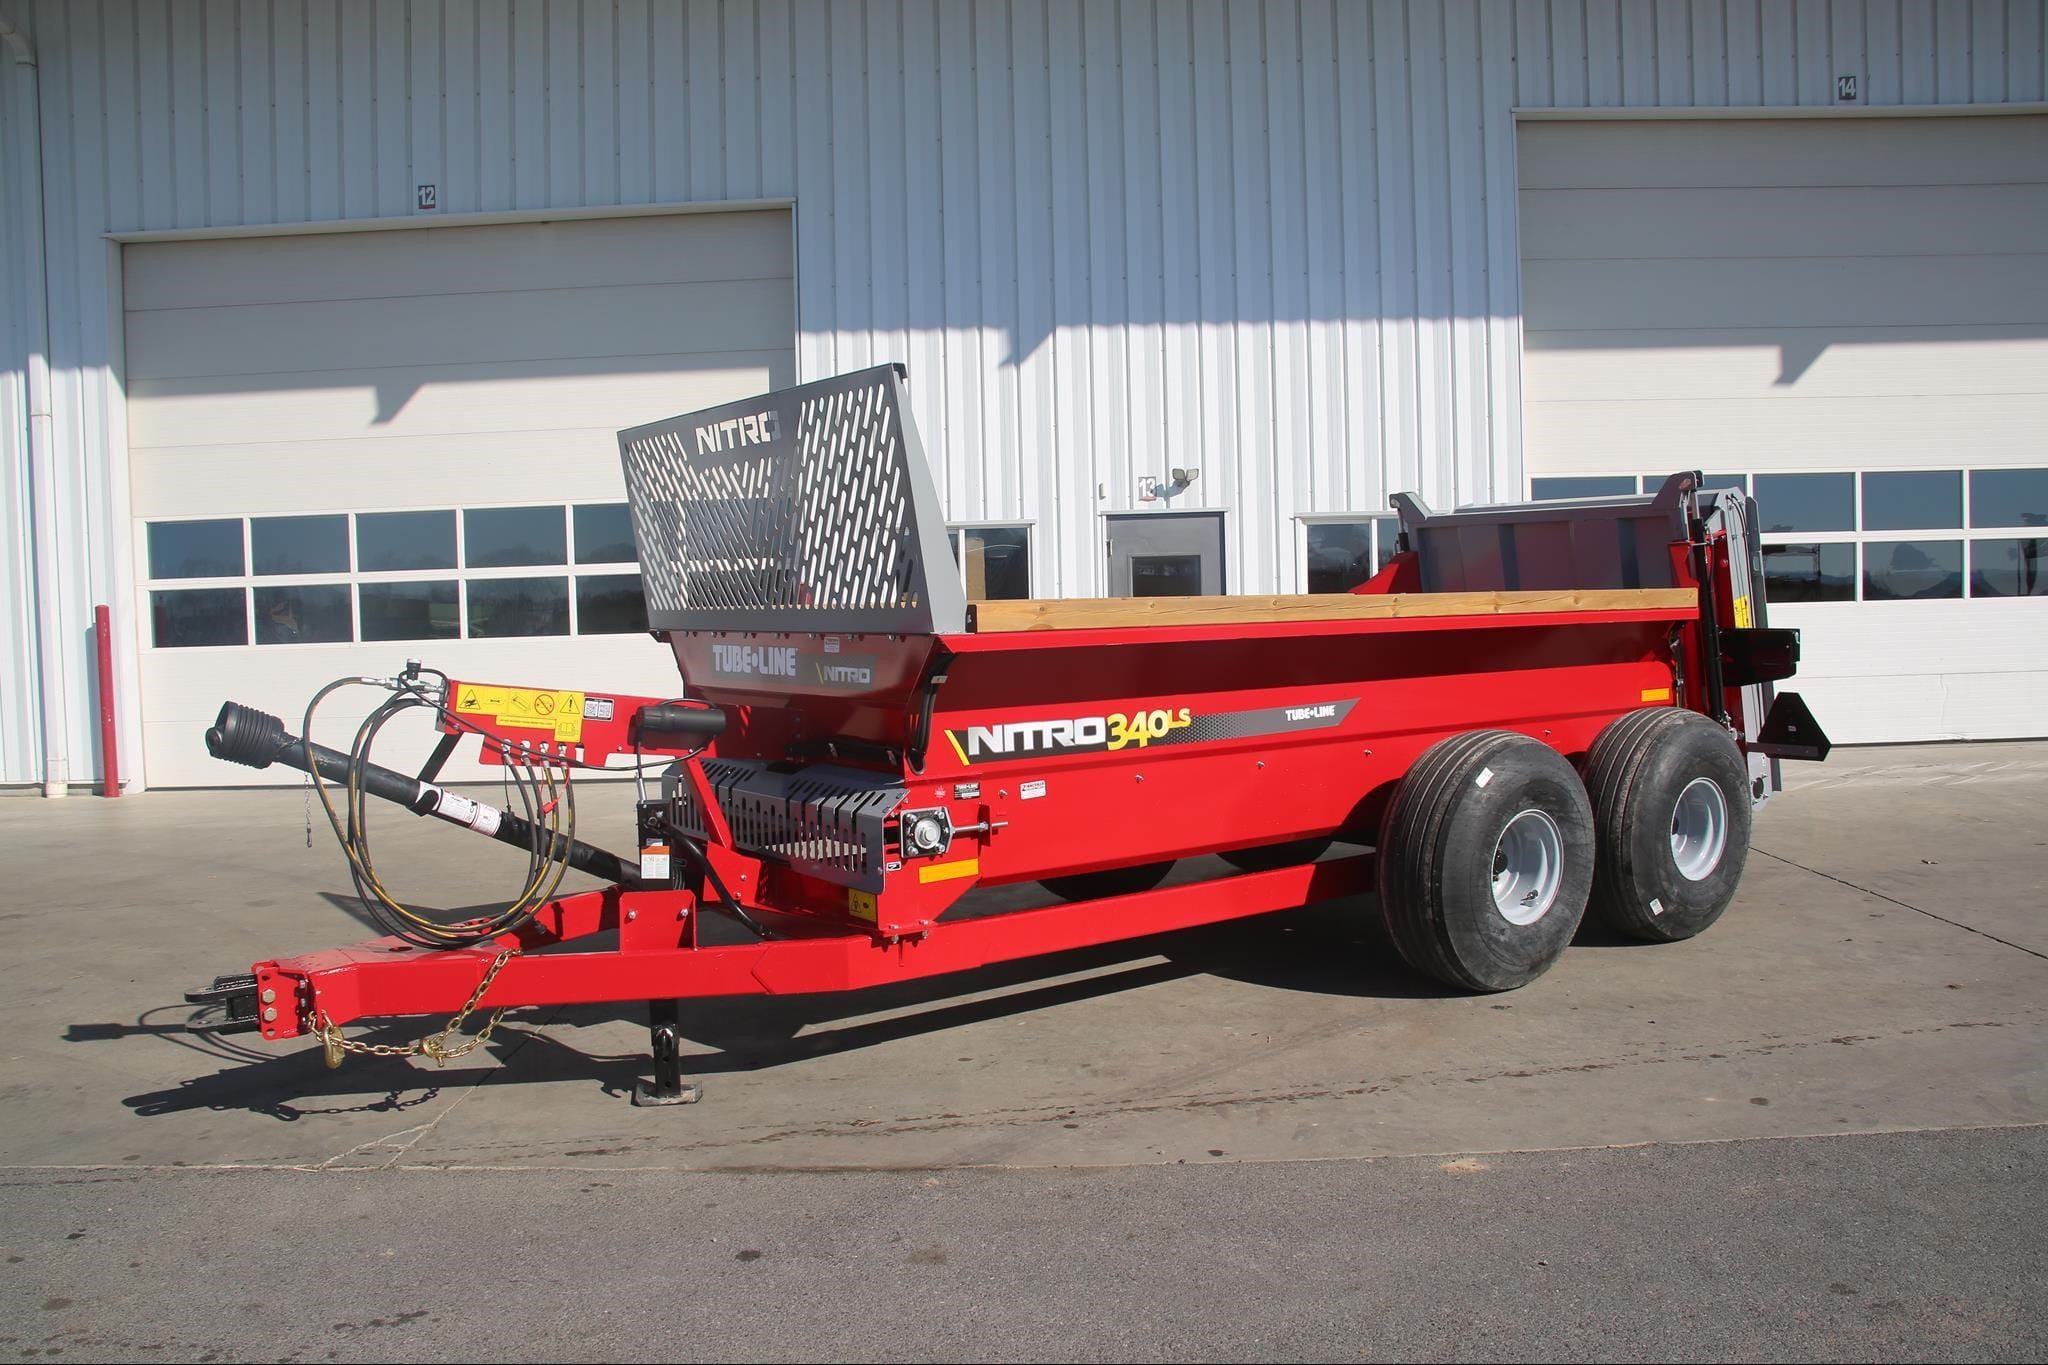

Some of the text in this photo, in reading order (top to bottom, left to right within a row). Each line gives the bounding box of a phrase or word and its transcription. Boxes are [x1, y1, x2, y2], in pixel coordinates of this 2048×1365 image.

[1839, 77, 1856, 97] 14
[418, 186, 435, 206] 12
[695, 410, 781, 455] NITRO
[1139, 477, 1156, 497] 13
[823, 665, 871, 684] NITRO
[968, 716, 1106, 756] NITRO
